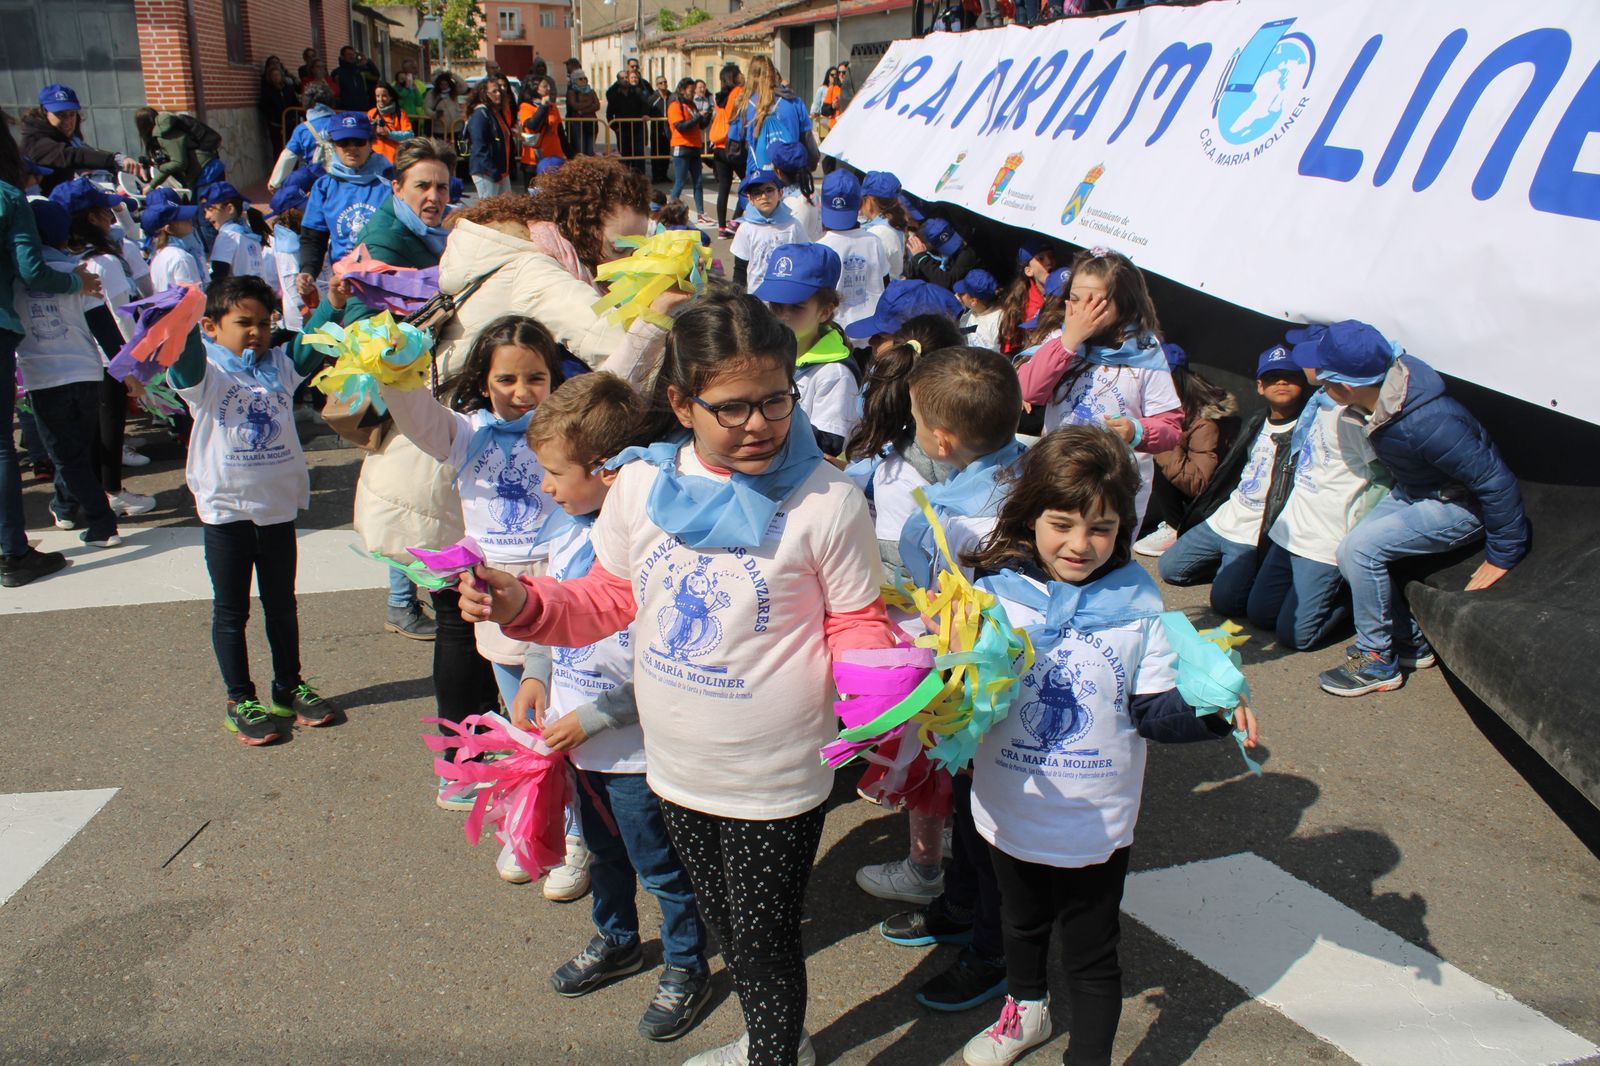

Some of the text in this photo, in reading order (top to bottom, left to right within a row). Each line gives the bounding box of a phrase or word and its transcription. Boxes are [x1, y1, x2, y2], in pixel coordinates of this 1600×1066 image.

[1215, 152, 1250, 167] MARIA
[1253, 96, 1310, 158] MOLINER
[496, 535, 526, 546] MARÍA
[743, 558, 771, 633] DANZARES
[1075, 632, 1103, 649] LOS
[654, 659, 684, 679] MARÍA
[686, 672, 746, 689] MOLINER
[1001, 748, 1019, 761] CRA
[1022, 754, 1059, 767] MARÍA
[1063, 758, 1113, 769] MOLINER
